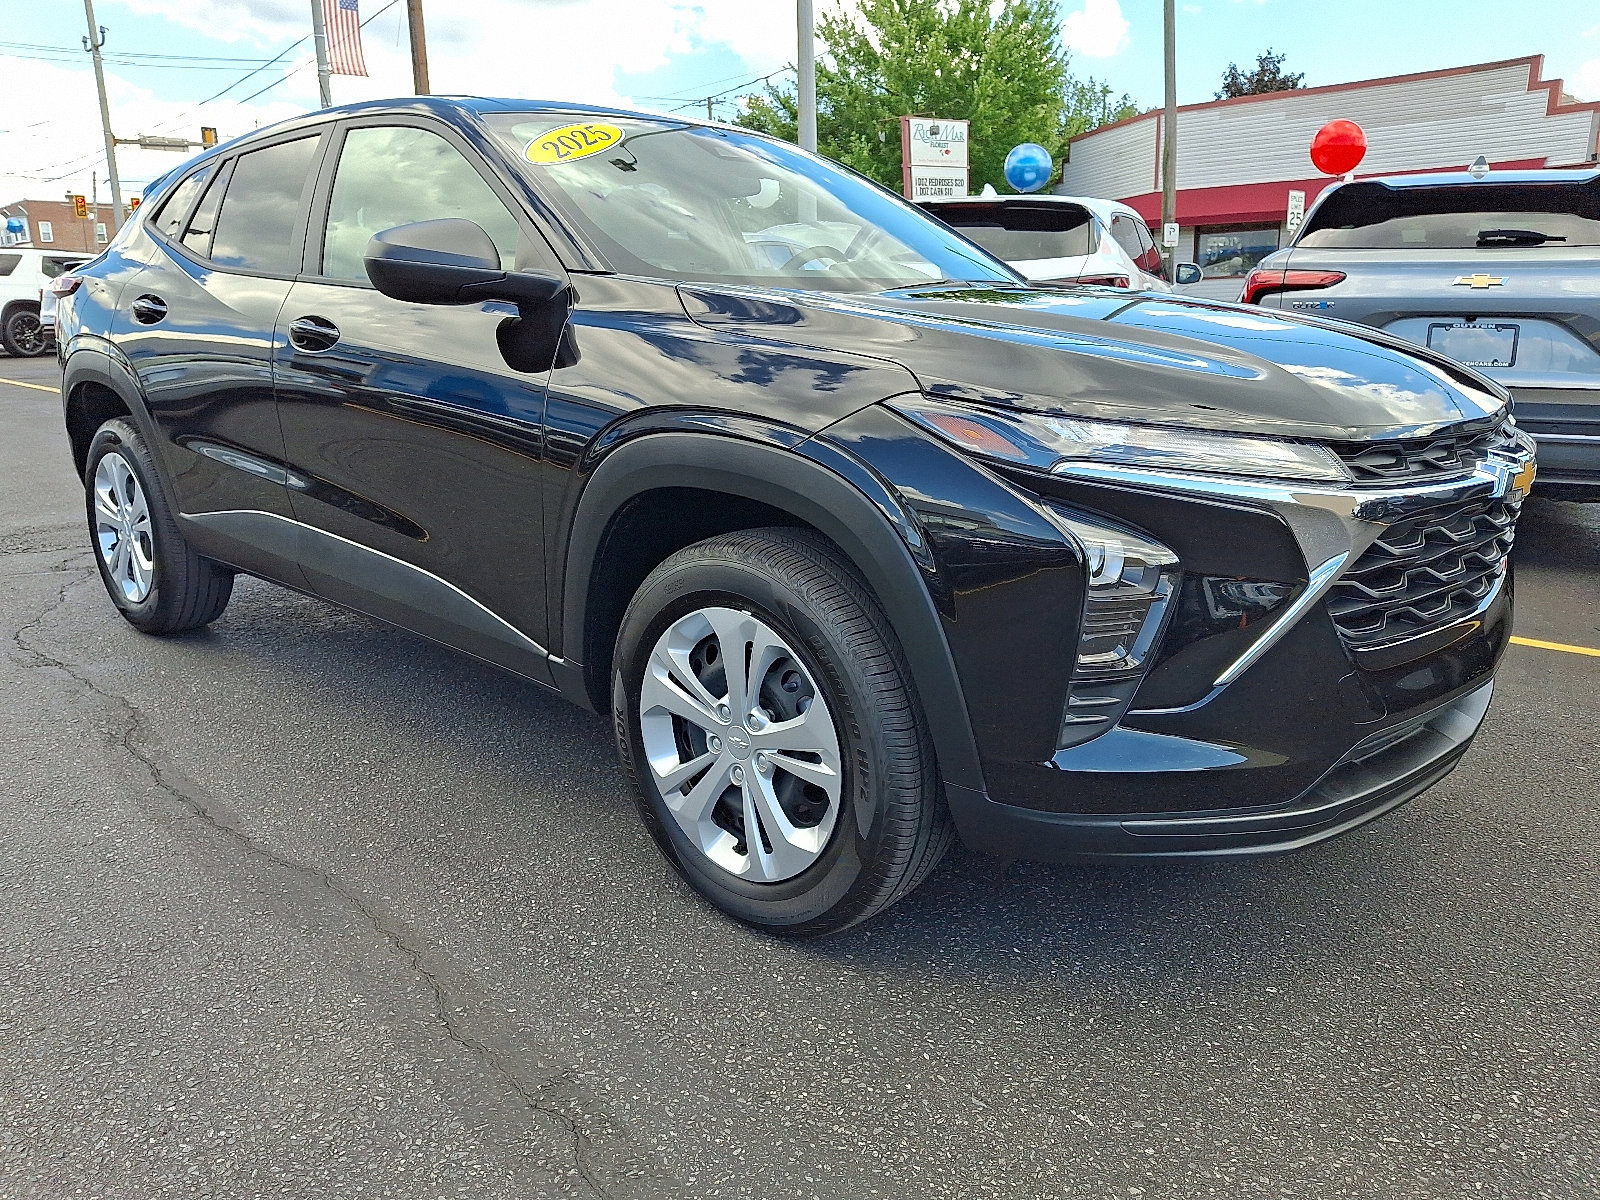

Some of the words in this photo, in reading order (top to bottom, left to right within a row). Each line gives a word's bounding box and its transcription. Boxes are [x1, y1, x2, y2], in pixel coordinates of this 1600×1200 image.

[940, 124, 965, 141] MAR
[542, 125, 611, 159] 2025
[929, 178, 938, 186] RED
[939, 178, 953, 187] ROSES
[955, 179, 964, 187] $20
[920, 187, 929, 195] DOZ
[944, 187, 953, 196] $10
[1290, 195, 1303, 203] SPEED
[1290, 211, 1303, 226] 25
